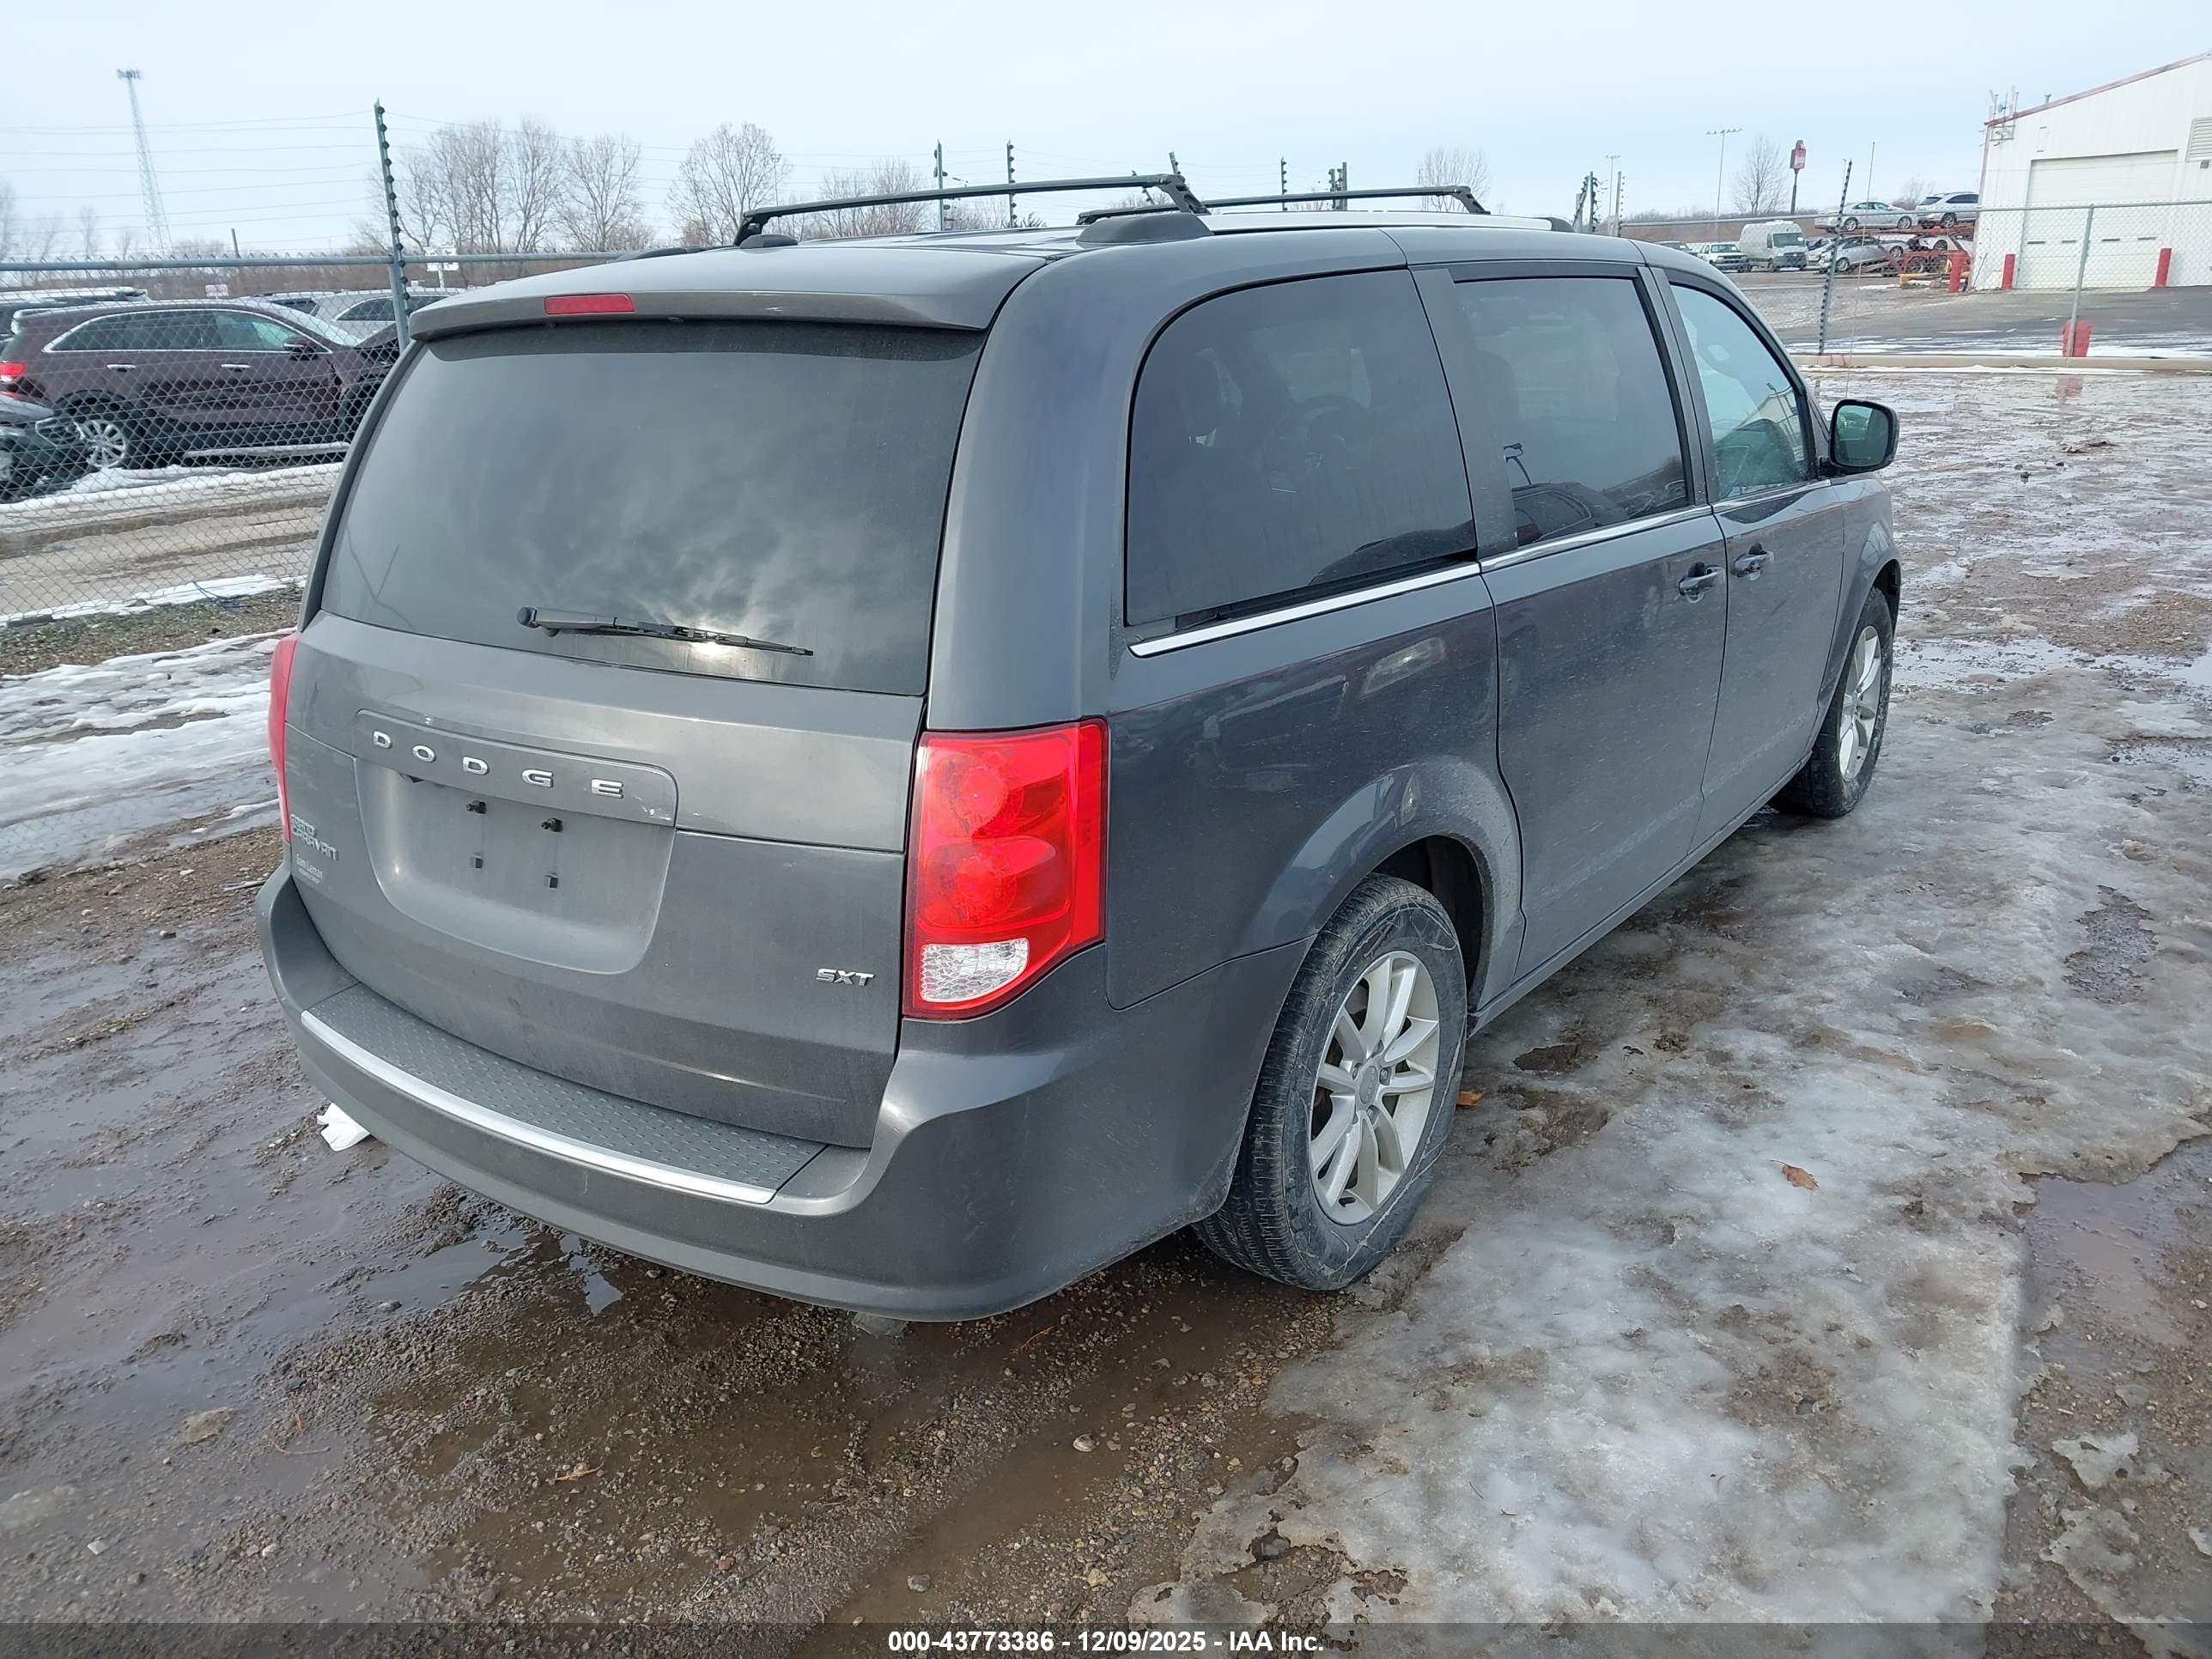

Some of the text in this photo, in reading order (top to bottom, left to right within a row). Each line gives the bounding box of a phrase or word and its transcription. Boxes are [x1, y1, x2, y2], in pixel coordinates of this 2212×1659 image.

[373, 730, 624, 799] DODGE
[292, 825, 337, 861] CARAVAN
[816, 968, 876, 987] SXT
